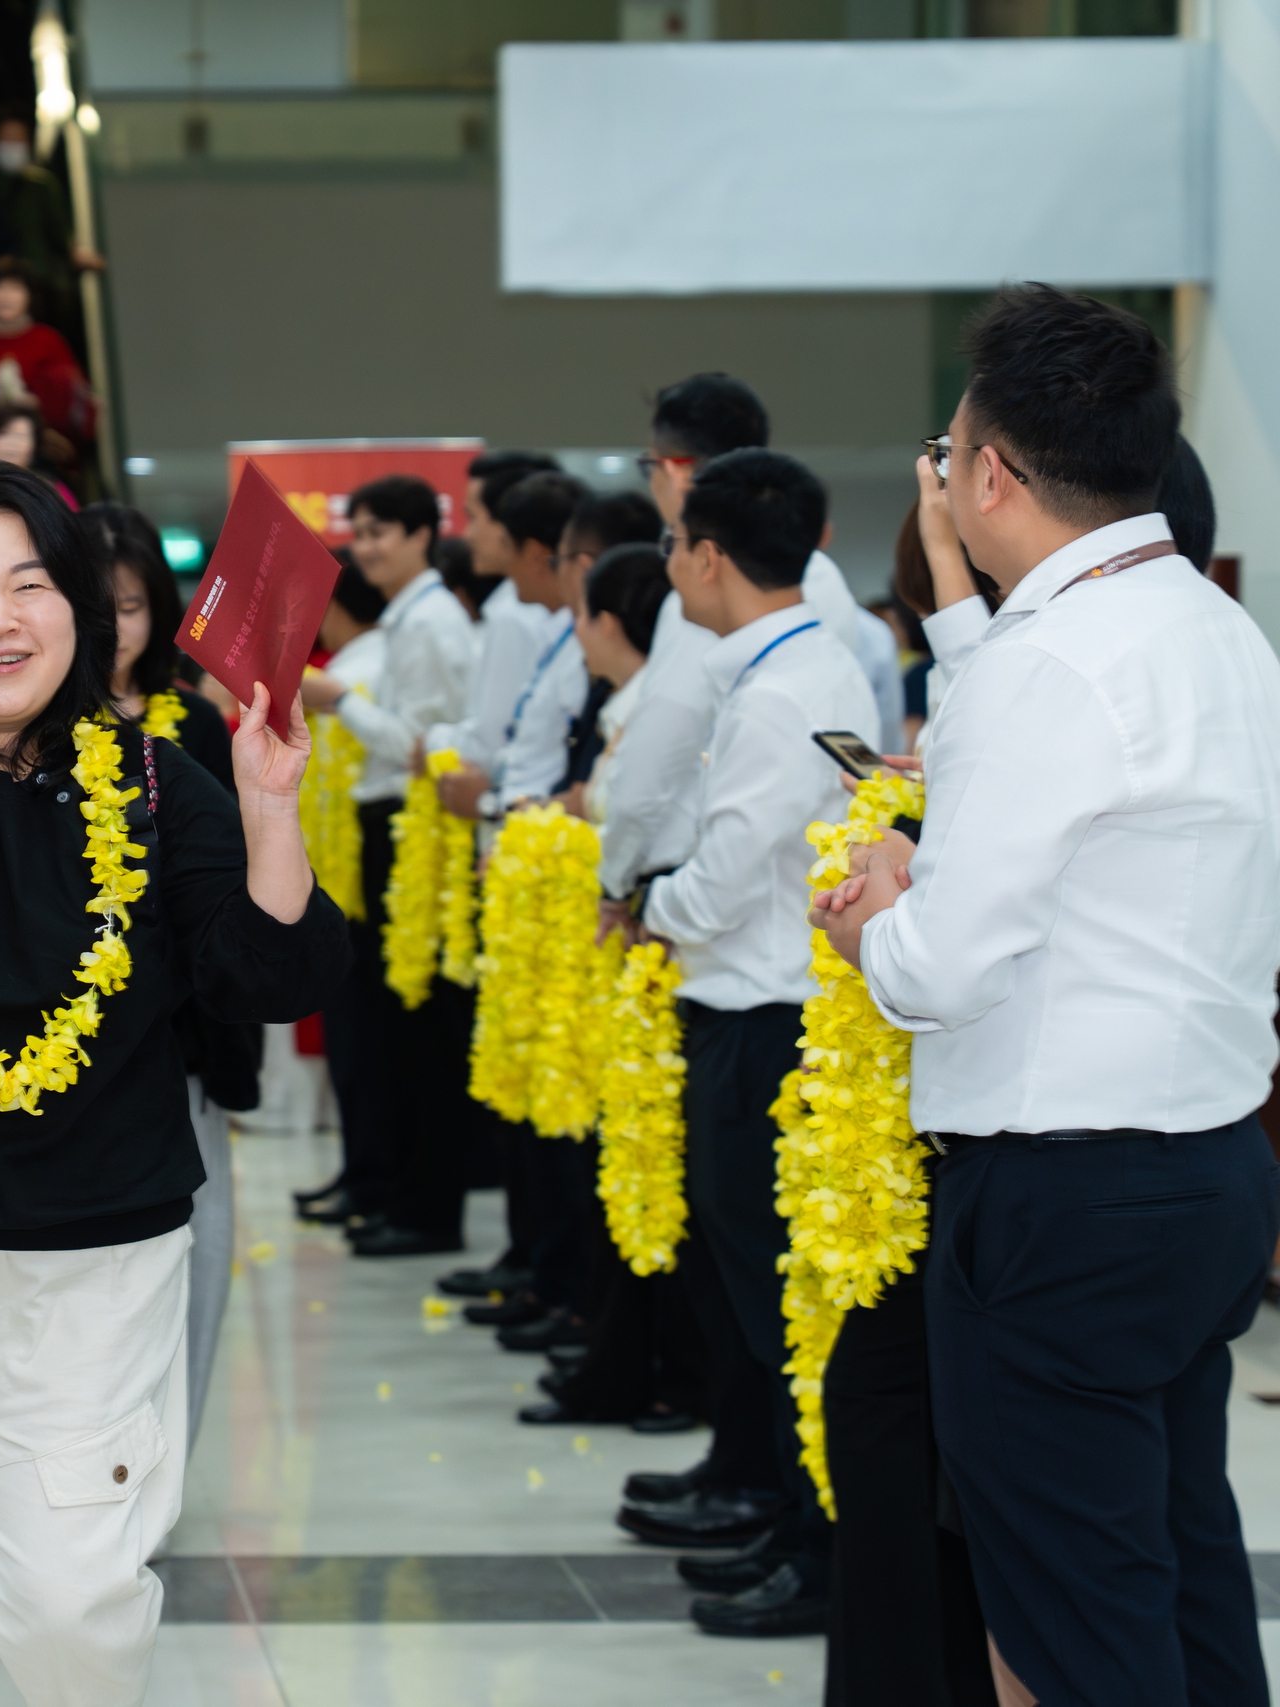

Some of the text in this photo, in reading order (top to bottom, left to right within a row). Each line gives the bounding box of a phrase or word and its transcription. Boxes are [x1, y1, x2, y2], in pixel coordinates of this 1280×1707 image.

[189, 614, 208, 641] SAC
[205, 584, 219, 606] AIRPORT
[224, 621, 252, 668] 푸꾸옥에
[246, 599, 259, 624] 오신
